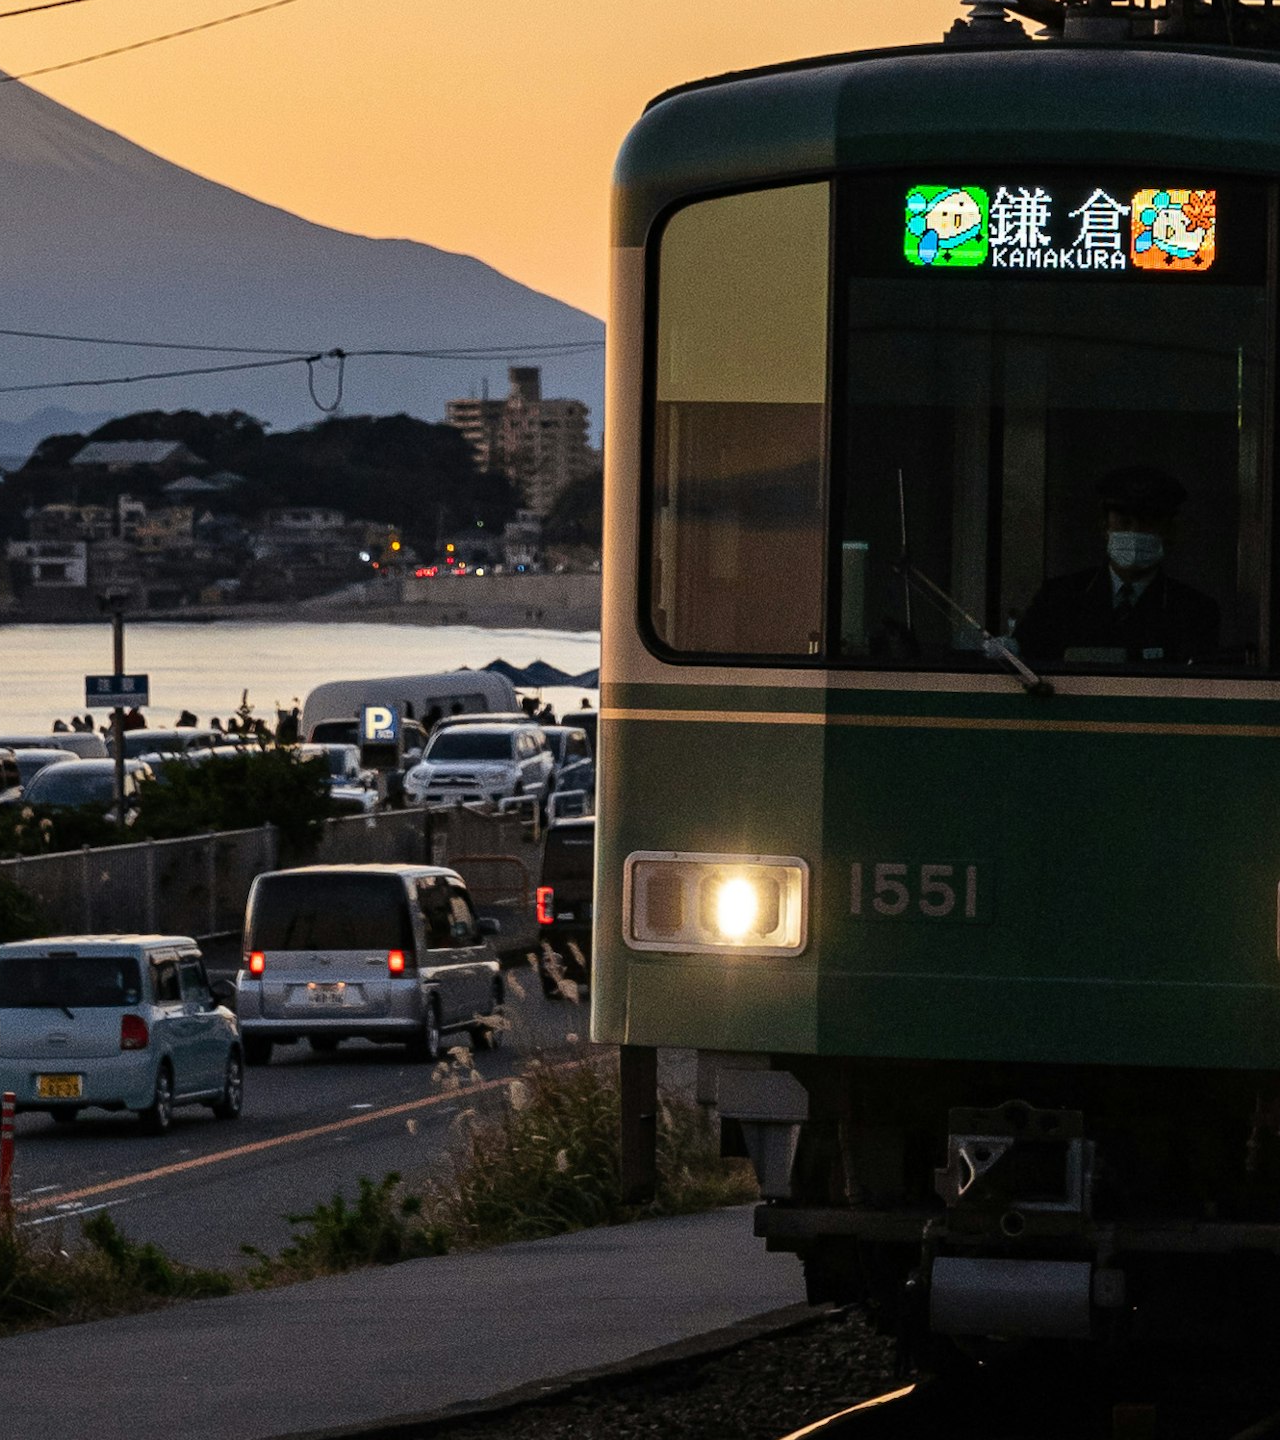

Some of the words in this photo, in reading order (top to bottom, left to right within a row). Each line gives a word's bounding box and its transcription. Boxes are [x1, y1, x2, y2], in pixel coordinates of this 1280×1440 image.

[989, 186, 1131, 248] 鎌倉
[991, 249, 1127, 269] KAMAKURA
[365, 706, 393, 740] P
[850, 863, 977, 917] 1551
